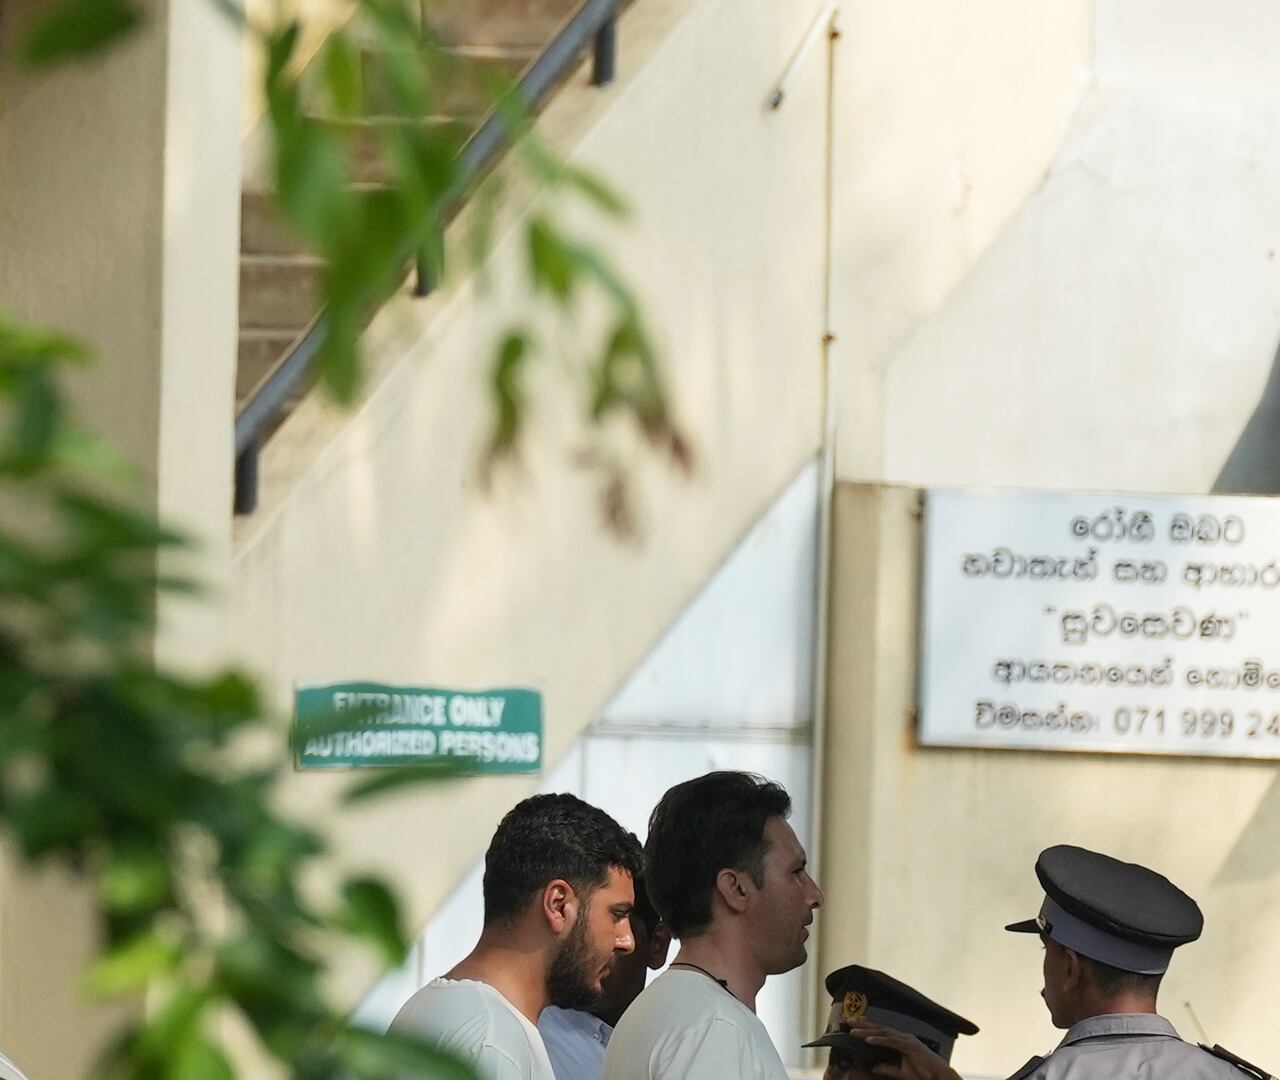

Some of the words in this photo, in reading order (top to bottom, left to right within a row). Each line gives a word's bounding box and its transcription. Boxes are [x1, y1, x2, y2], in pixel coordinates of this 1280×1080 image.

[1168, 513, 1245, 545] ඔබට
[1112, 558, 1168, 585] සහ
[448, 694, 506, 727] ONLY
[1114, 706, 1167, 736] 071
[1180, 708, 1236, 738] 999
[303, 729, 438, 757] AUTHORIZED
[438, 730, 540, 763] PERSONS
